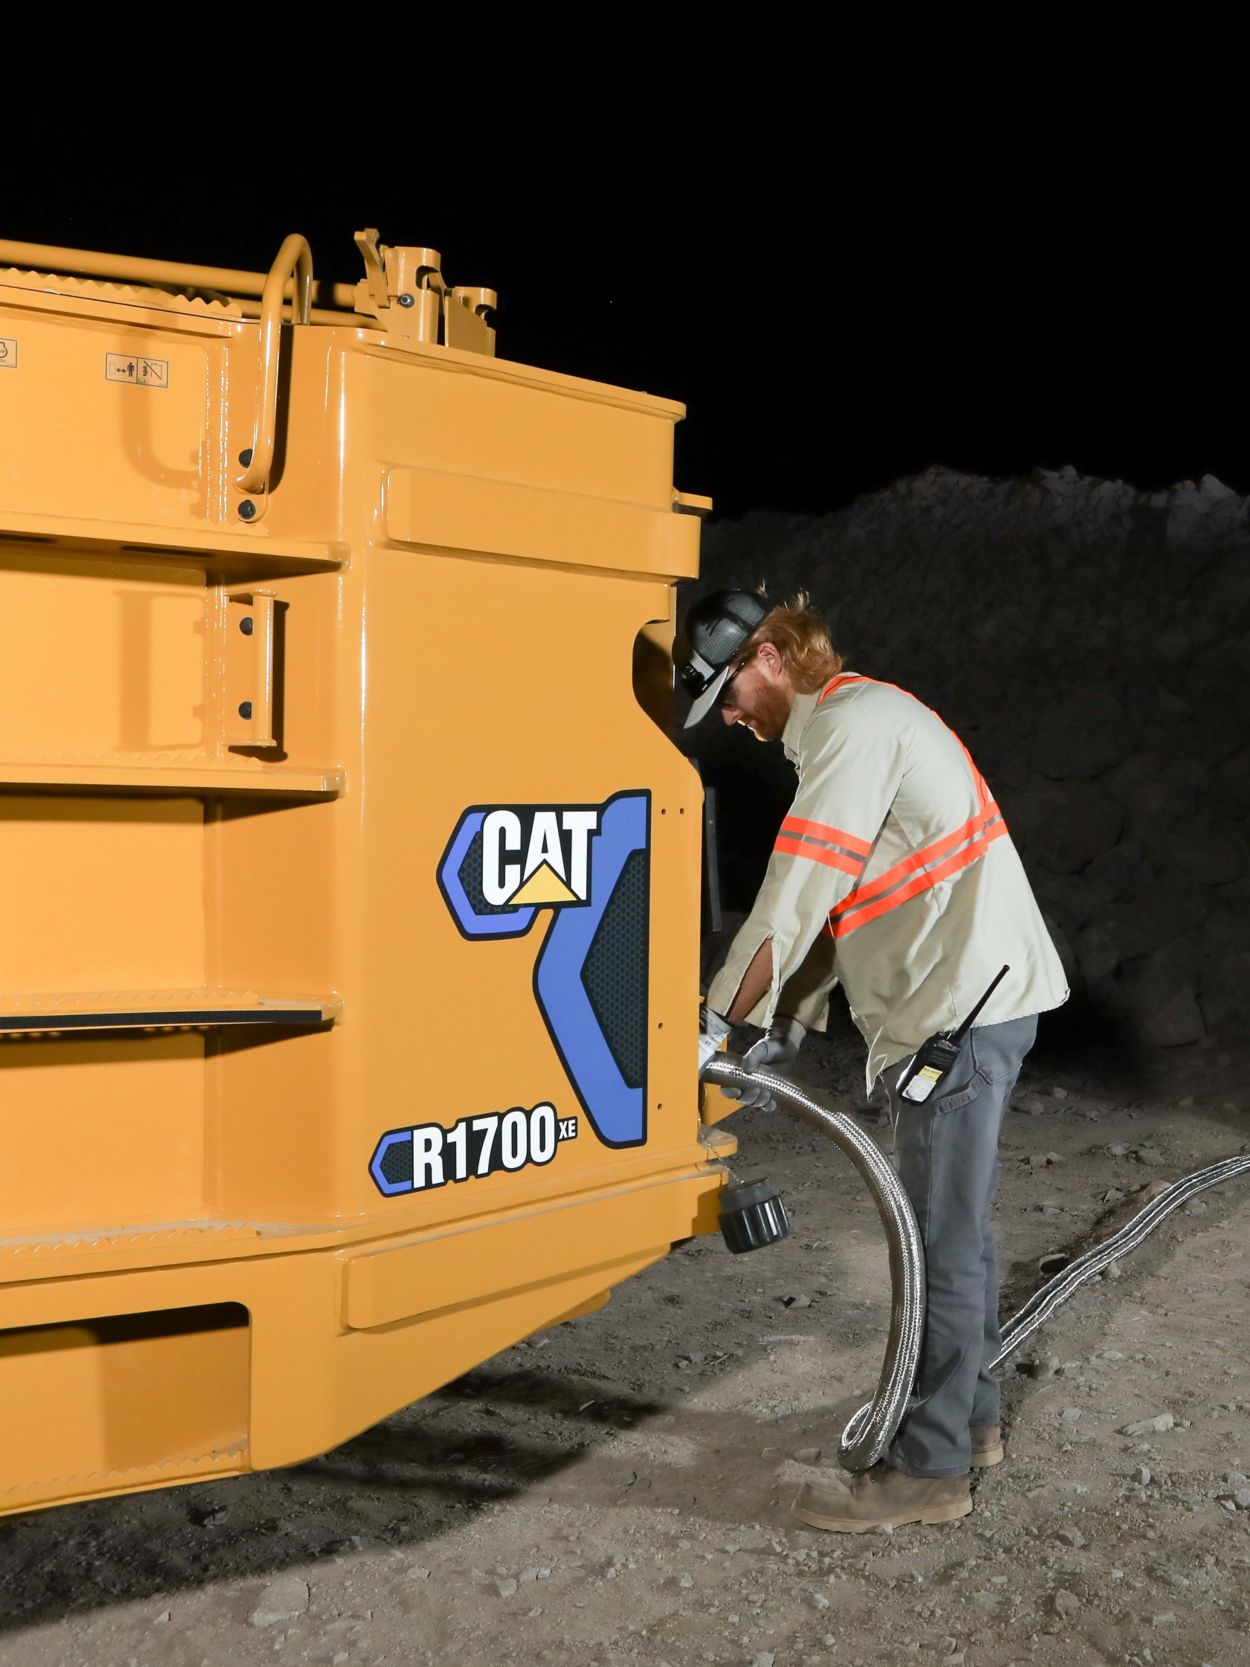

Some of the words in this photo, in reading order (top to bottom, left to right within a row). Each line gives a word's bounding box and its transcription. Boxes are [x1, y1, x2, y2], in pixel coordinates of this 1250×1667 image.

[483, 810, 597, 905] CAT
[413, 1106, 555, 1189] R1700
[558, 1119, 577, 1140] XE
